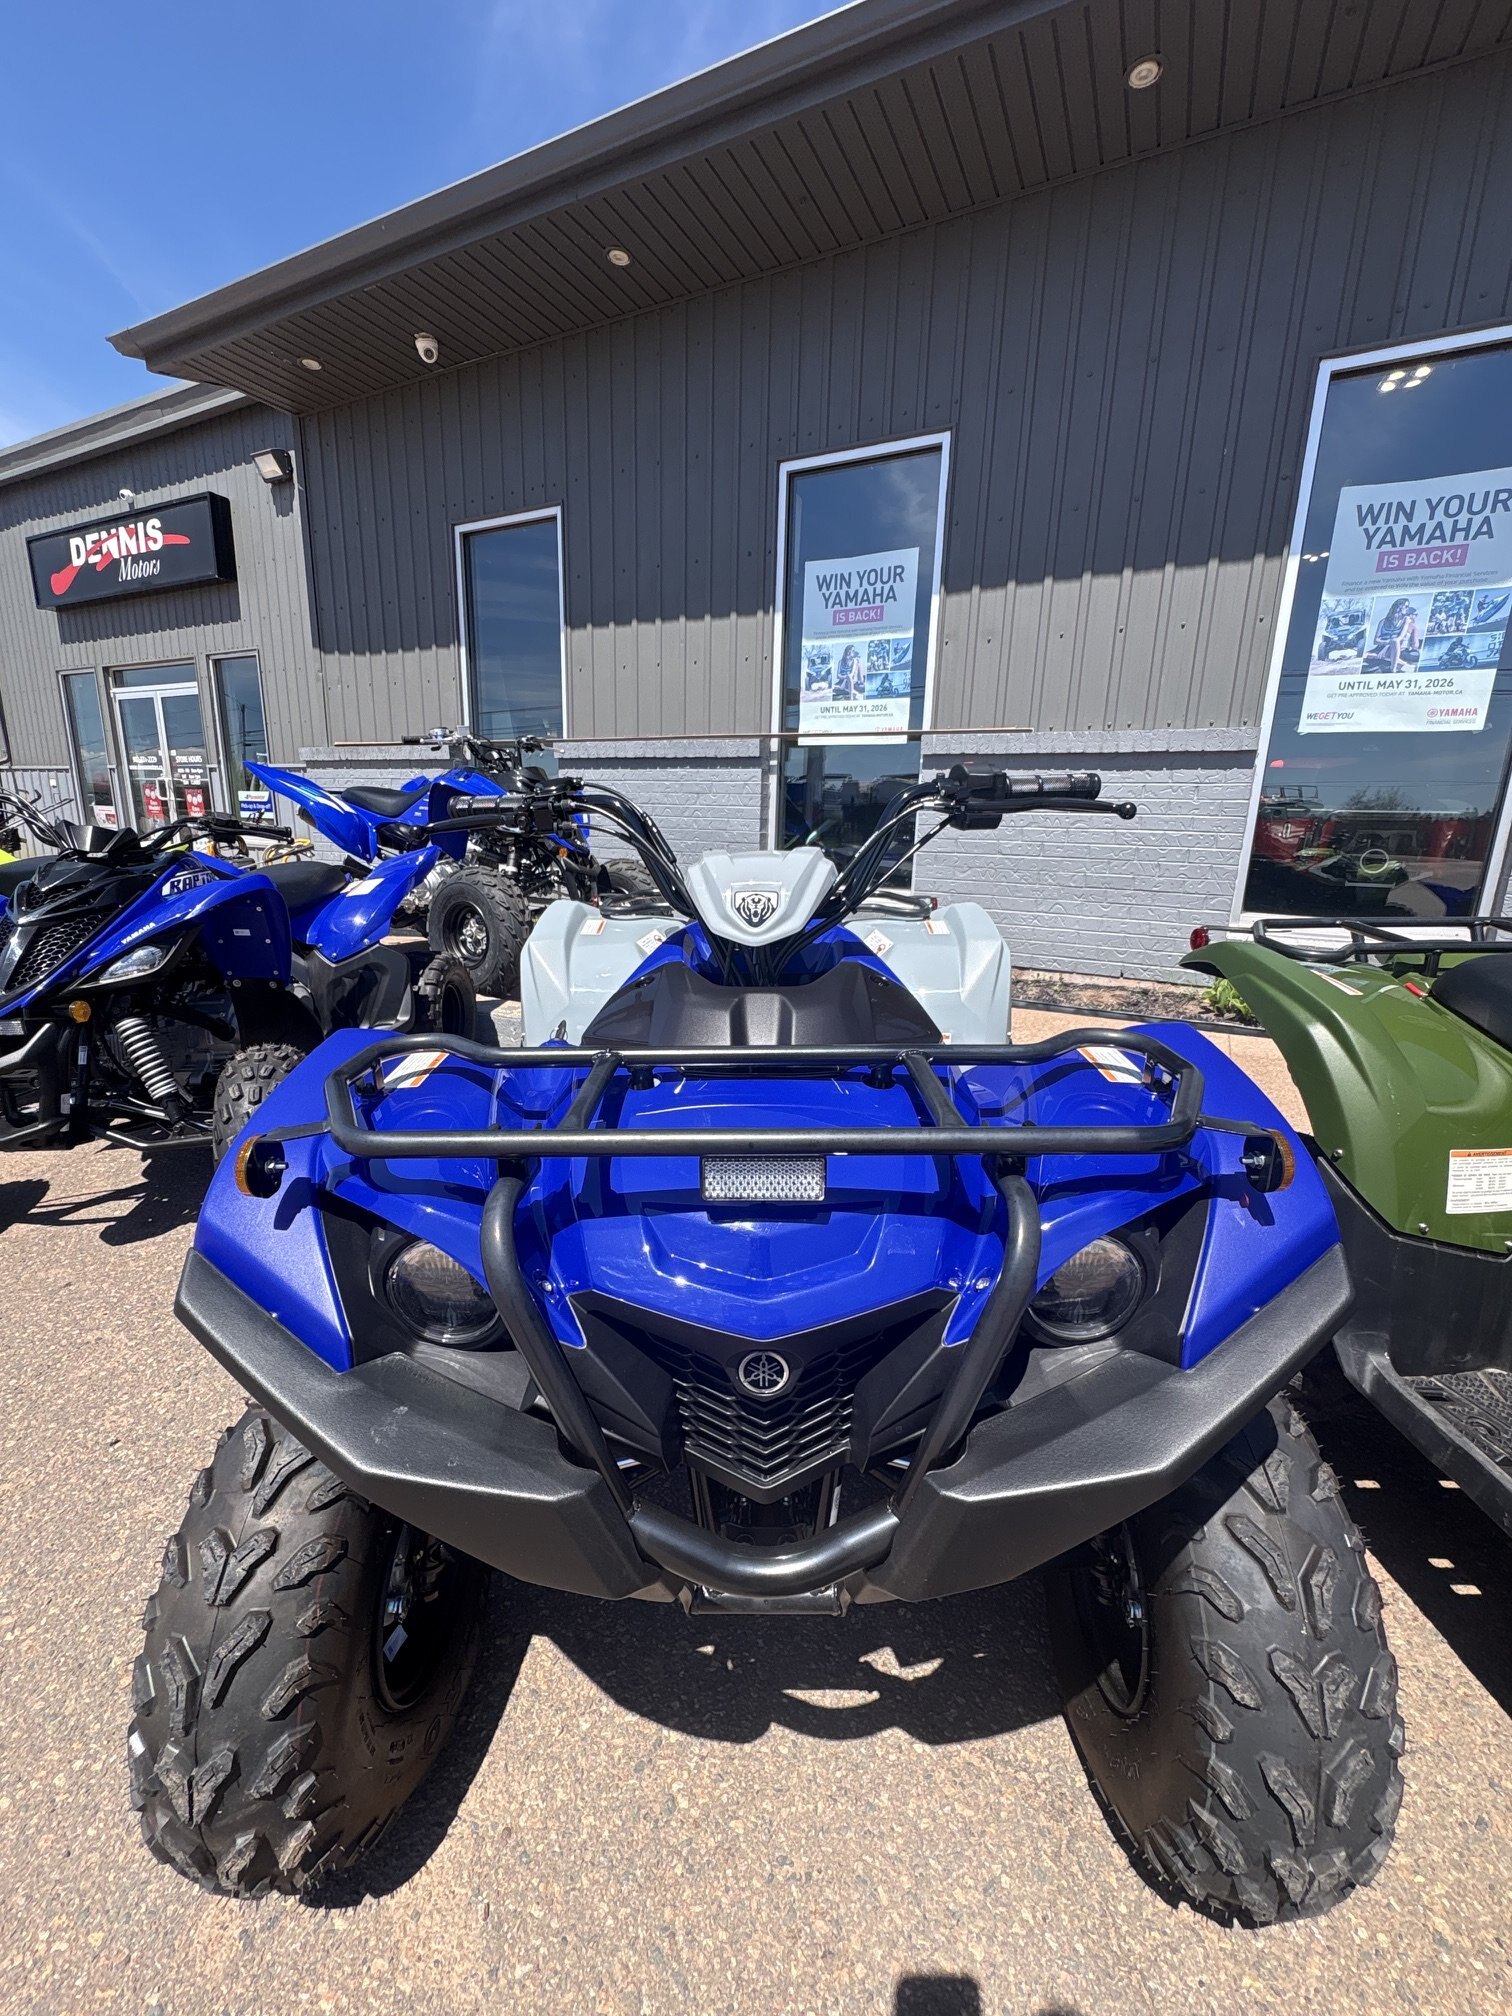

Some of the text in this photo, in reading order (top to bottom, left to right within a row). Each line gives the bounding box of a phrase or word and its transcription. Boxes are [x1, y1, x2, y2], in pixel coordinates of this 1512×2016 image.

[1356, 488, 1512, 527] WIN YOUR
[69, 518, 163, 567] DENNIS
[1363, 515, 1494, 550] YAMAHA
[118, 557, 161, 582] Motors
[1382, 550, 1462, 569] IS BACK!
[816, 565, 905, 592] WIN YOUR
[822, 585, 897, 609] YAMAHA
[836, 609, 881, 623] IS BACK!
[1338, 677, 1454, 691] UNTIL MAY 31, 2026
[820, 704, 888, 714] UNTIL MAY 31, 2026
[1439, 708, 1478, 717] YAMAHA
[121, 922, 156, 945] YAMAHA
